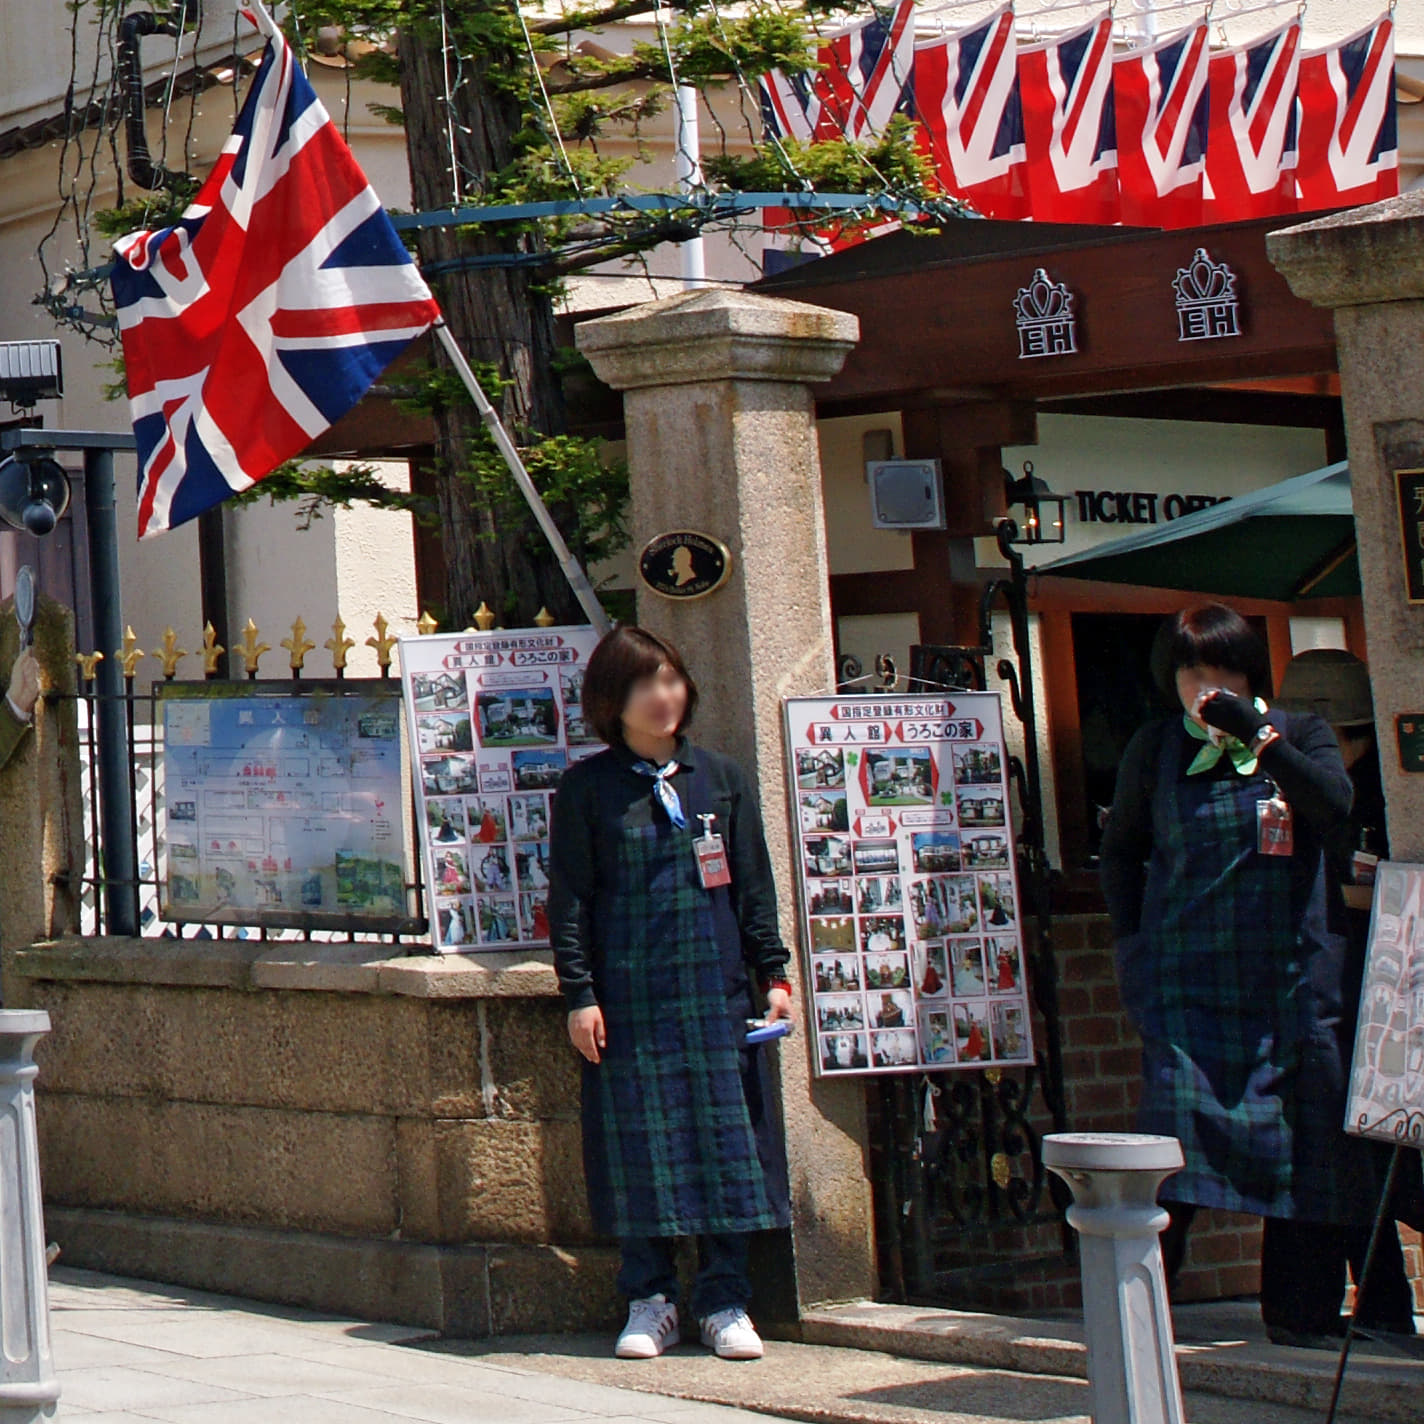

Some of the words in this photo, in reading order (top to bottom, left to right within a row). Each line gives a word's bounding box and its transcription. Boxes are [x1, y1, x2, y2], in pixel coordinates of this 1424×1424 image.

[1075, 490, 1158, 524] TICKET
[518, 650, 570, 664] うろこの家
[907, 722, 974, 740] うろこの家
